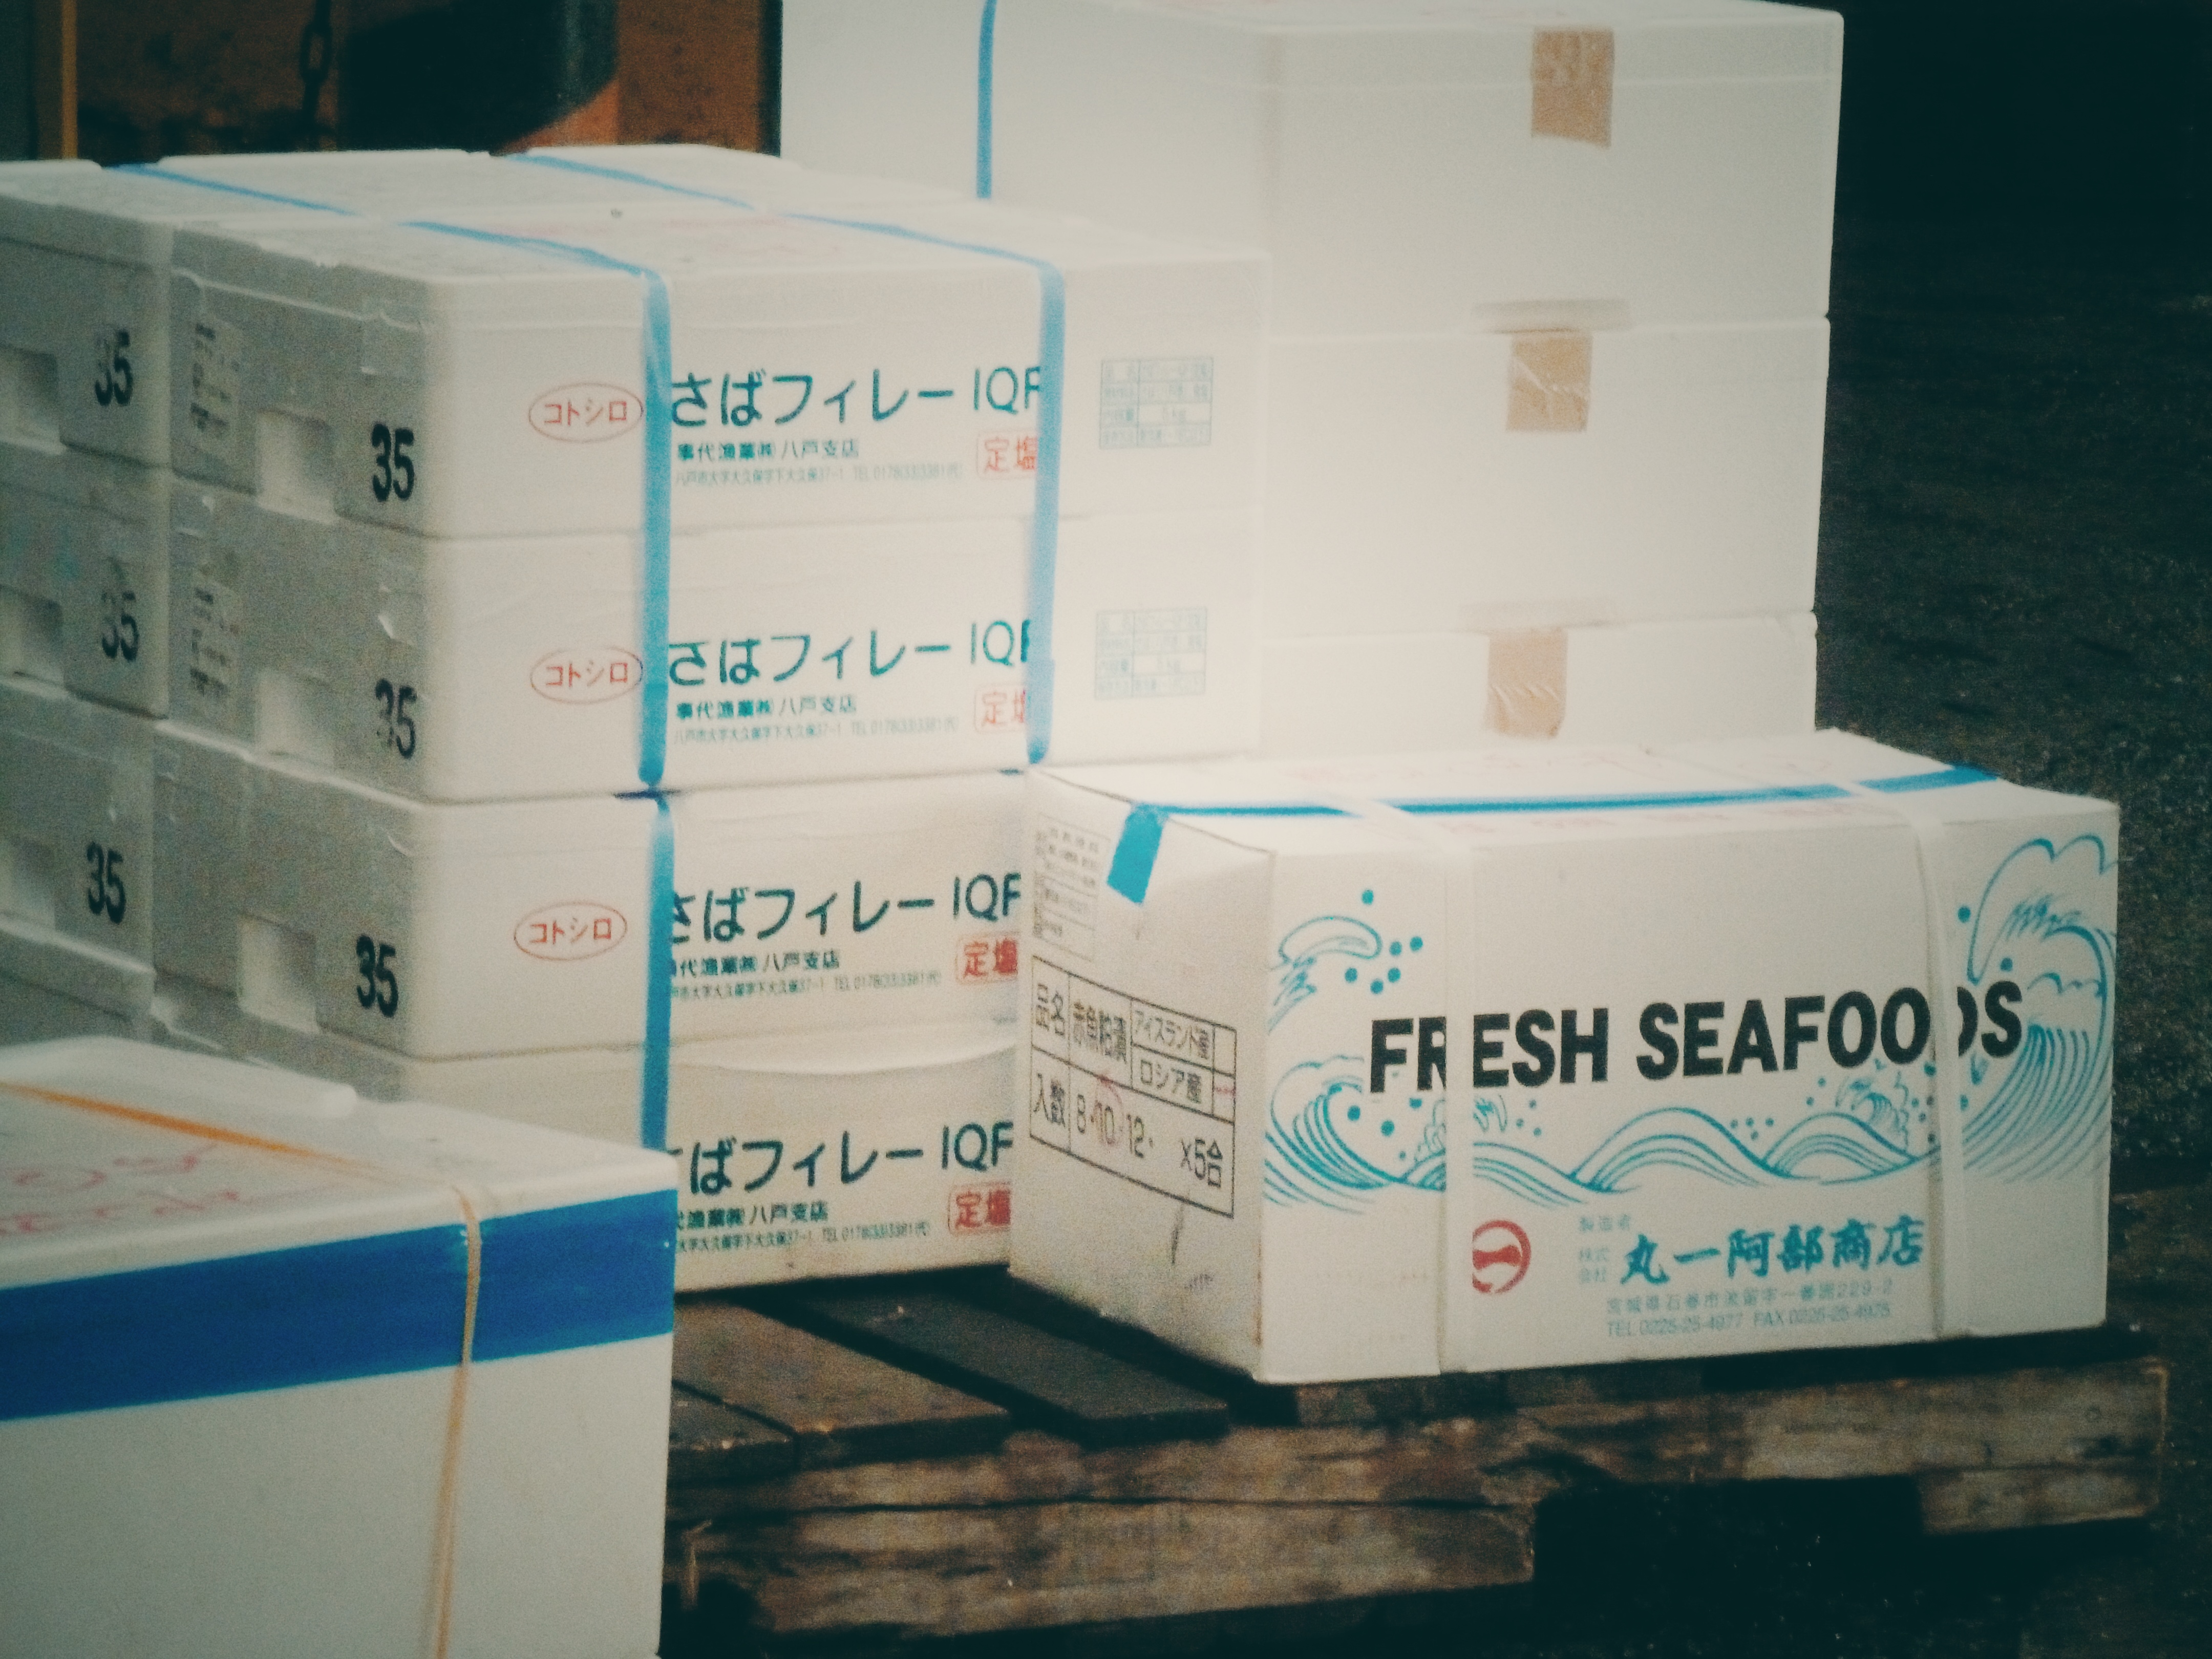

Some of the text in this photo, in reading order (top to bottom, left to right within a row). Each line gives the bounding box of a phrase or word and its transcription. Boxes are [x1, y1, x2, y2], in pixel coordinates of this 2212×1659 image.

[544, 399, 628, 427] コトシロ
[671, 368, 953, 427] さばフィレー
[371, 423, 414, 501] 35
[546, 662, 628, 689] コトシロ
[87, 842, 126, 922] 35
[953, 873, 1021, 922] IQF
[529, 917, 612, 946] コトシロ
[355, 934, 398, 1018] 35
[1370, 1007, 1609, 1093] FRESH
[670, 1122, 1014, 1195] ばフィレー IQF
[1620, 1215, 1924, 1285] 丸一阿部商店
